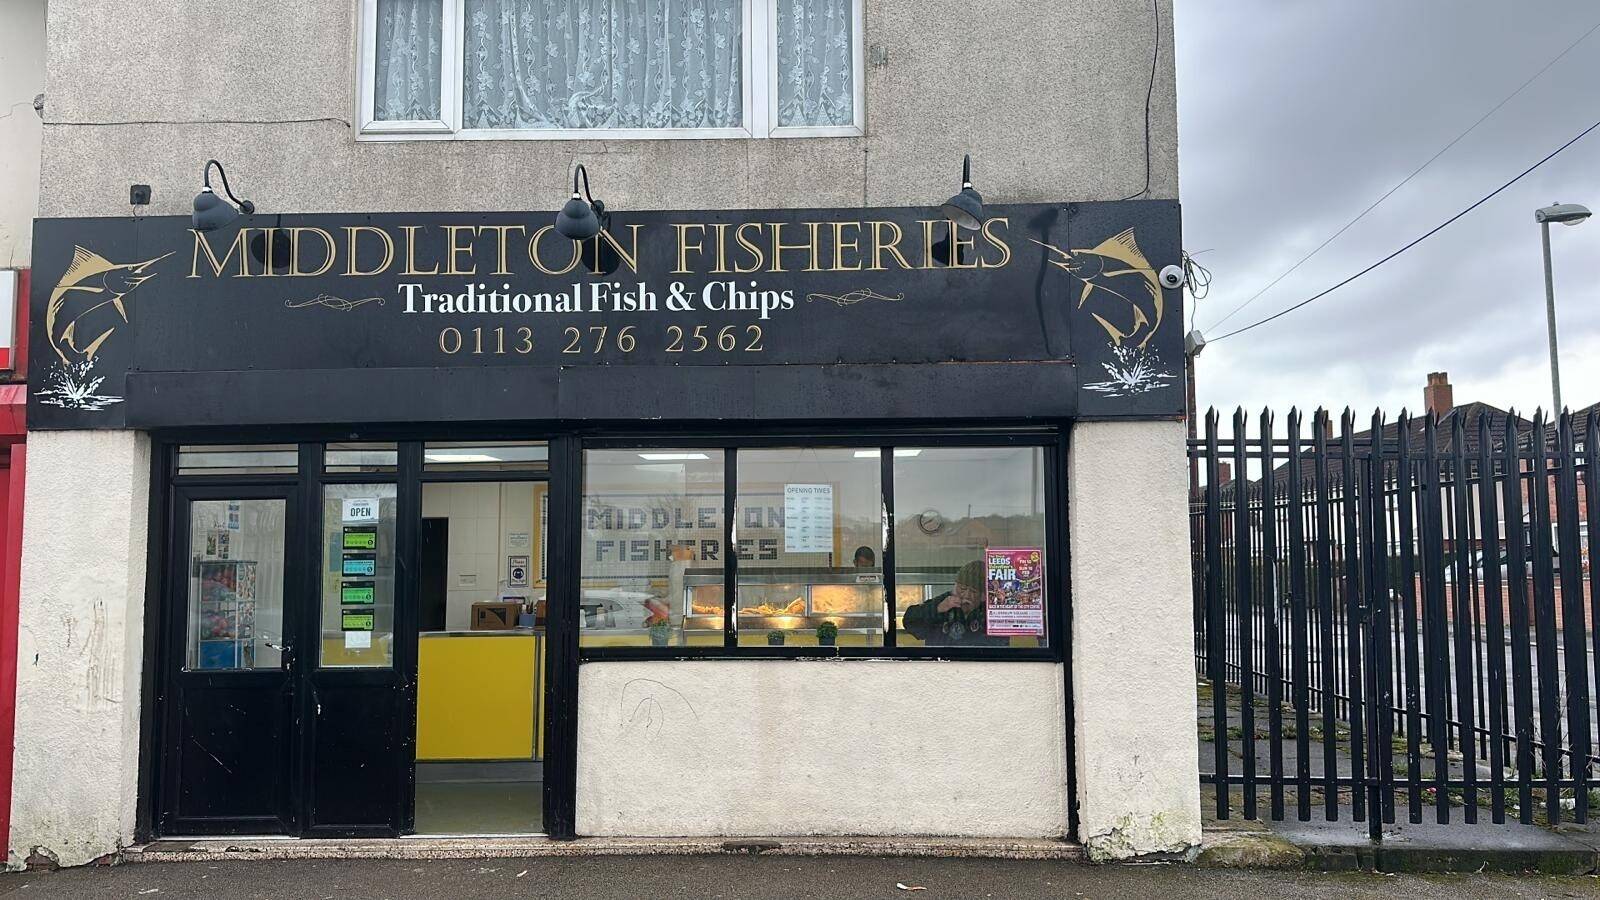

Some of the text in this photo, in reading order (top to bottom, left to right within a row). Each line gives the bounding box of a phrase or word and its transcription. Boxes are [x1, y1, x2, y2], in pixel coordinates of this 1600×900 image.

[186, 217, 1011, 278] MIDDLETON FISHERIES
[397, 280, 795, 320] Traditional Fish & Chips
[439, 325, 764, 354] 0113 276 2562
[350, 507, 371, 517] OPEN
[587, 507, 786, 530] MIDDLEON
[596, 539, 778, 561] FISHRES
[988, 557, 1011, 565] LEEDS
[988, 568, 1016, 580] FAIR
